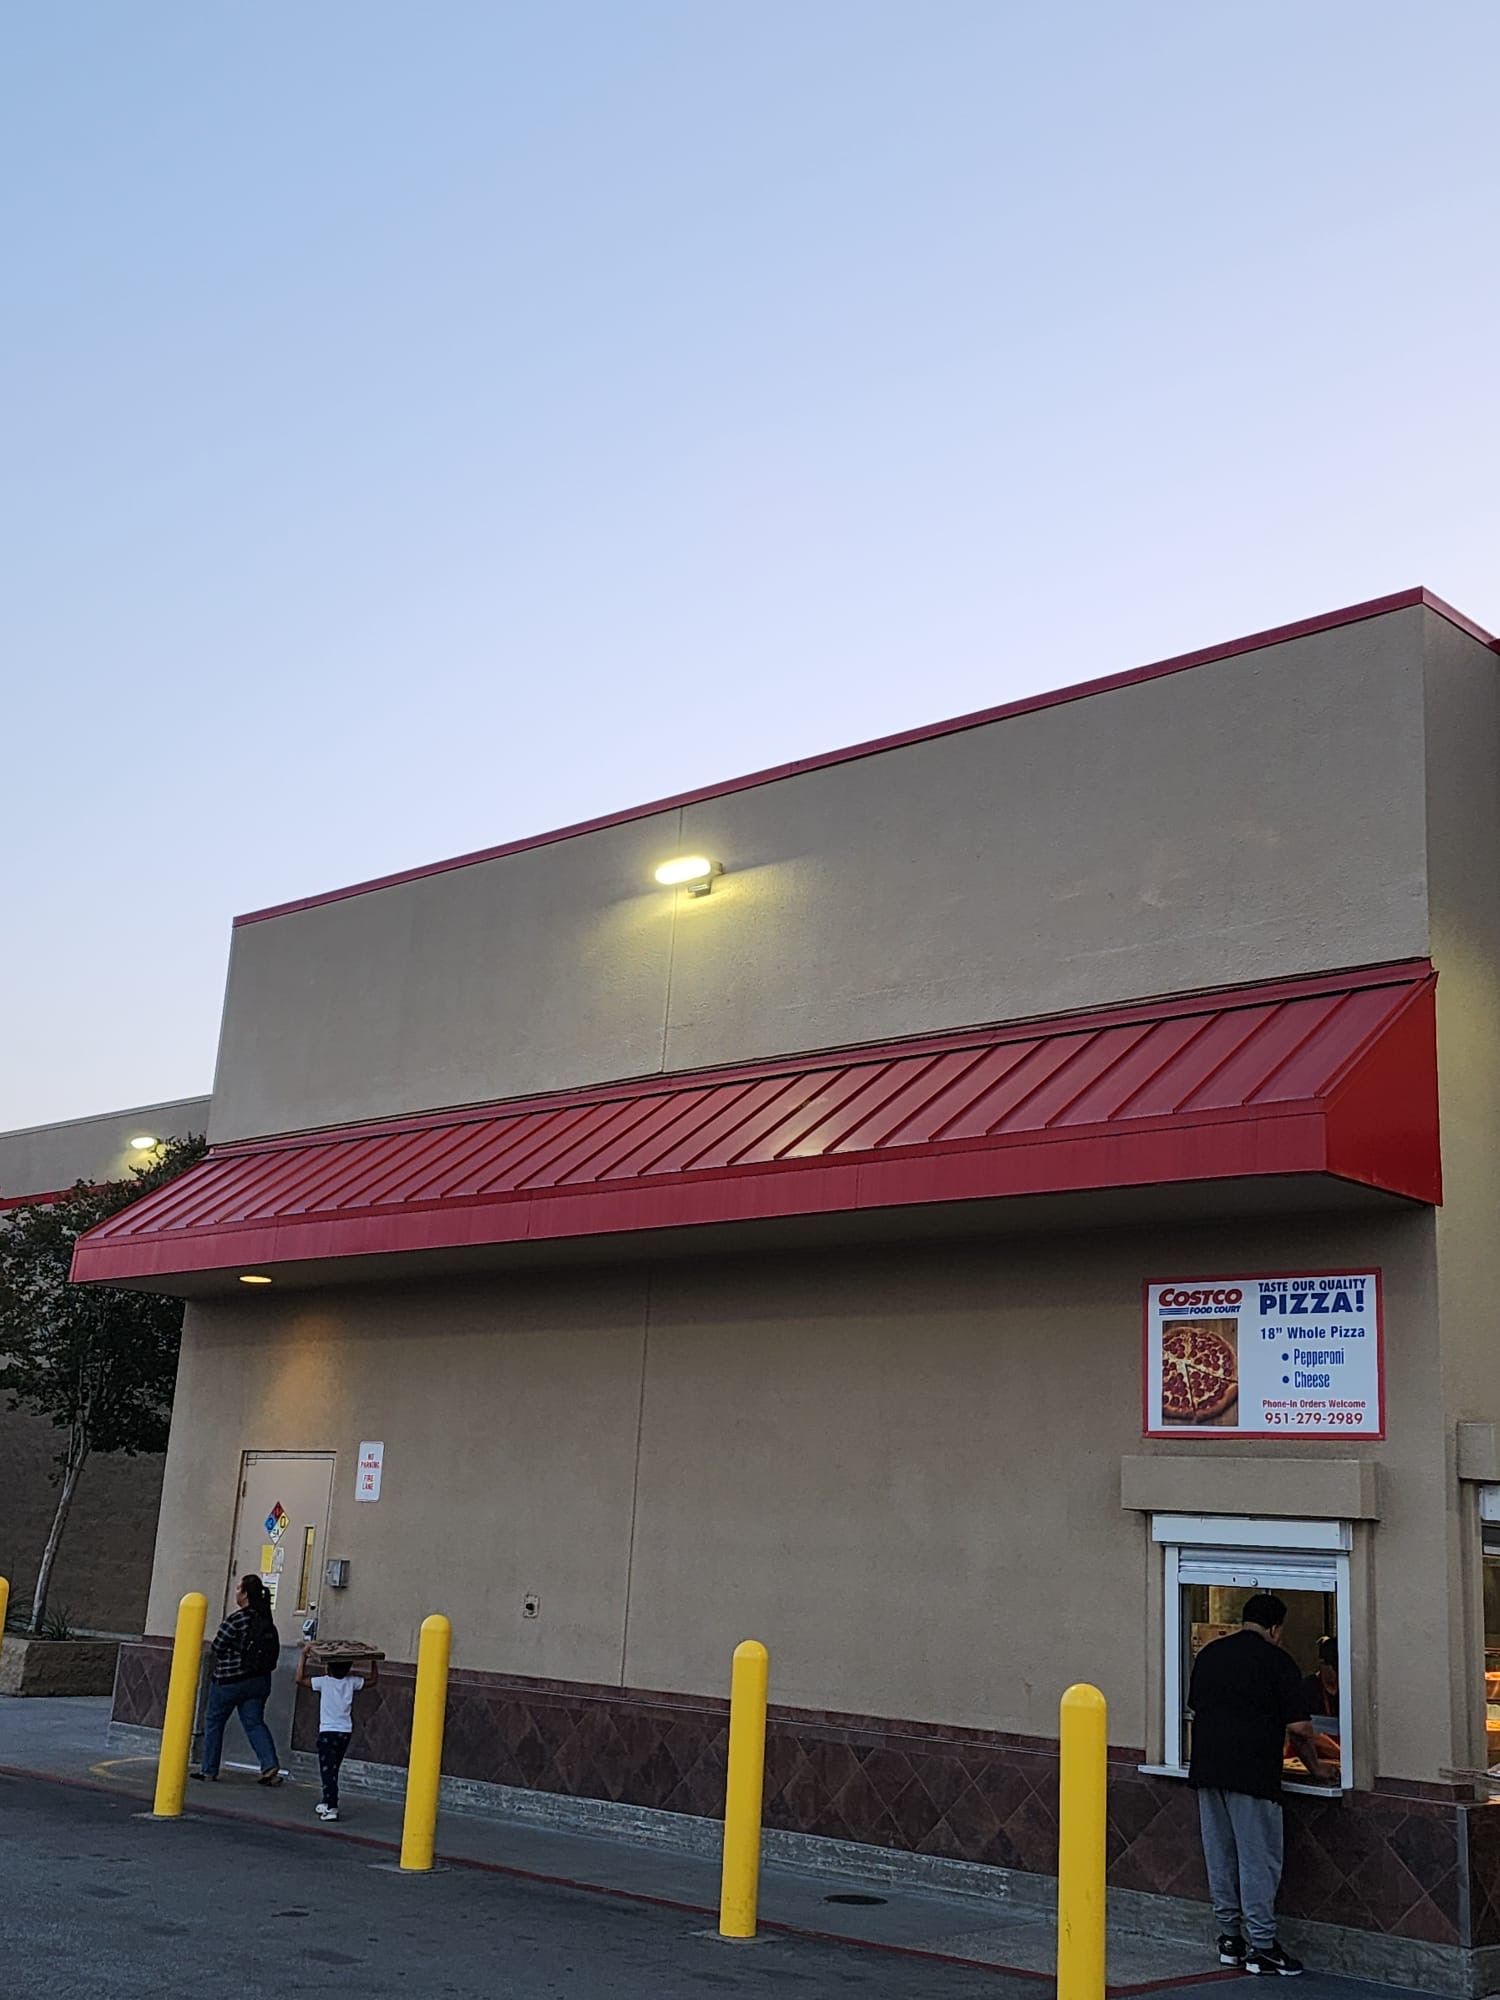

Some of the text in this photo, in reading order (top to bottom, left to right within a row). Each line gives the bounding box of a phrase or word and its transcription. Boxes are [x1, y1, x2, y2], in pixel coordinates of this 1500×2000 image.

[1259, 1279, 1366, 1293] TASTE OUR QUALITY
[1260, 1290, 1365, 1315] PIZZA!
[1190, 1305, 1241, 1314] FOOD COURT
[1288, 1327, 1325, 1338] Whole
[1331, 1326, 1365, 1337] Pizza
[1294, 1348, 1344, 1367] Pepperoni
[1294, 1371, 1330, 1388] Cheese
[1300, 1400, 1326, 1408] Orders
[1329, 1400, 1365, 1408] Welcome
[1265, 1412, 1363, 1425] 951-279-2989
